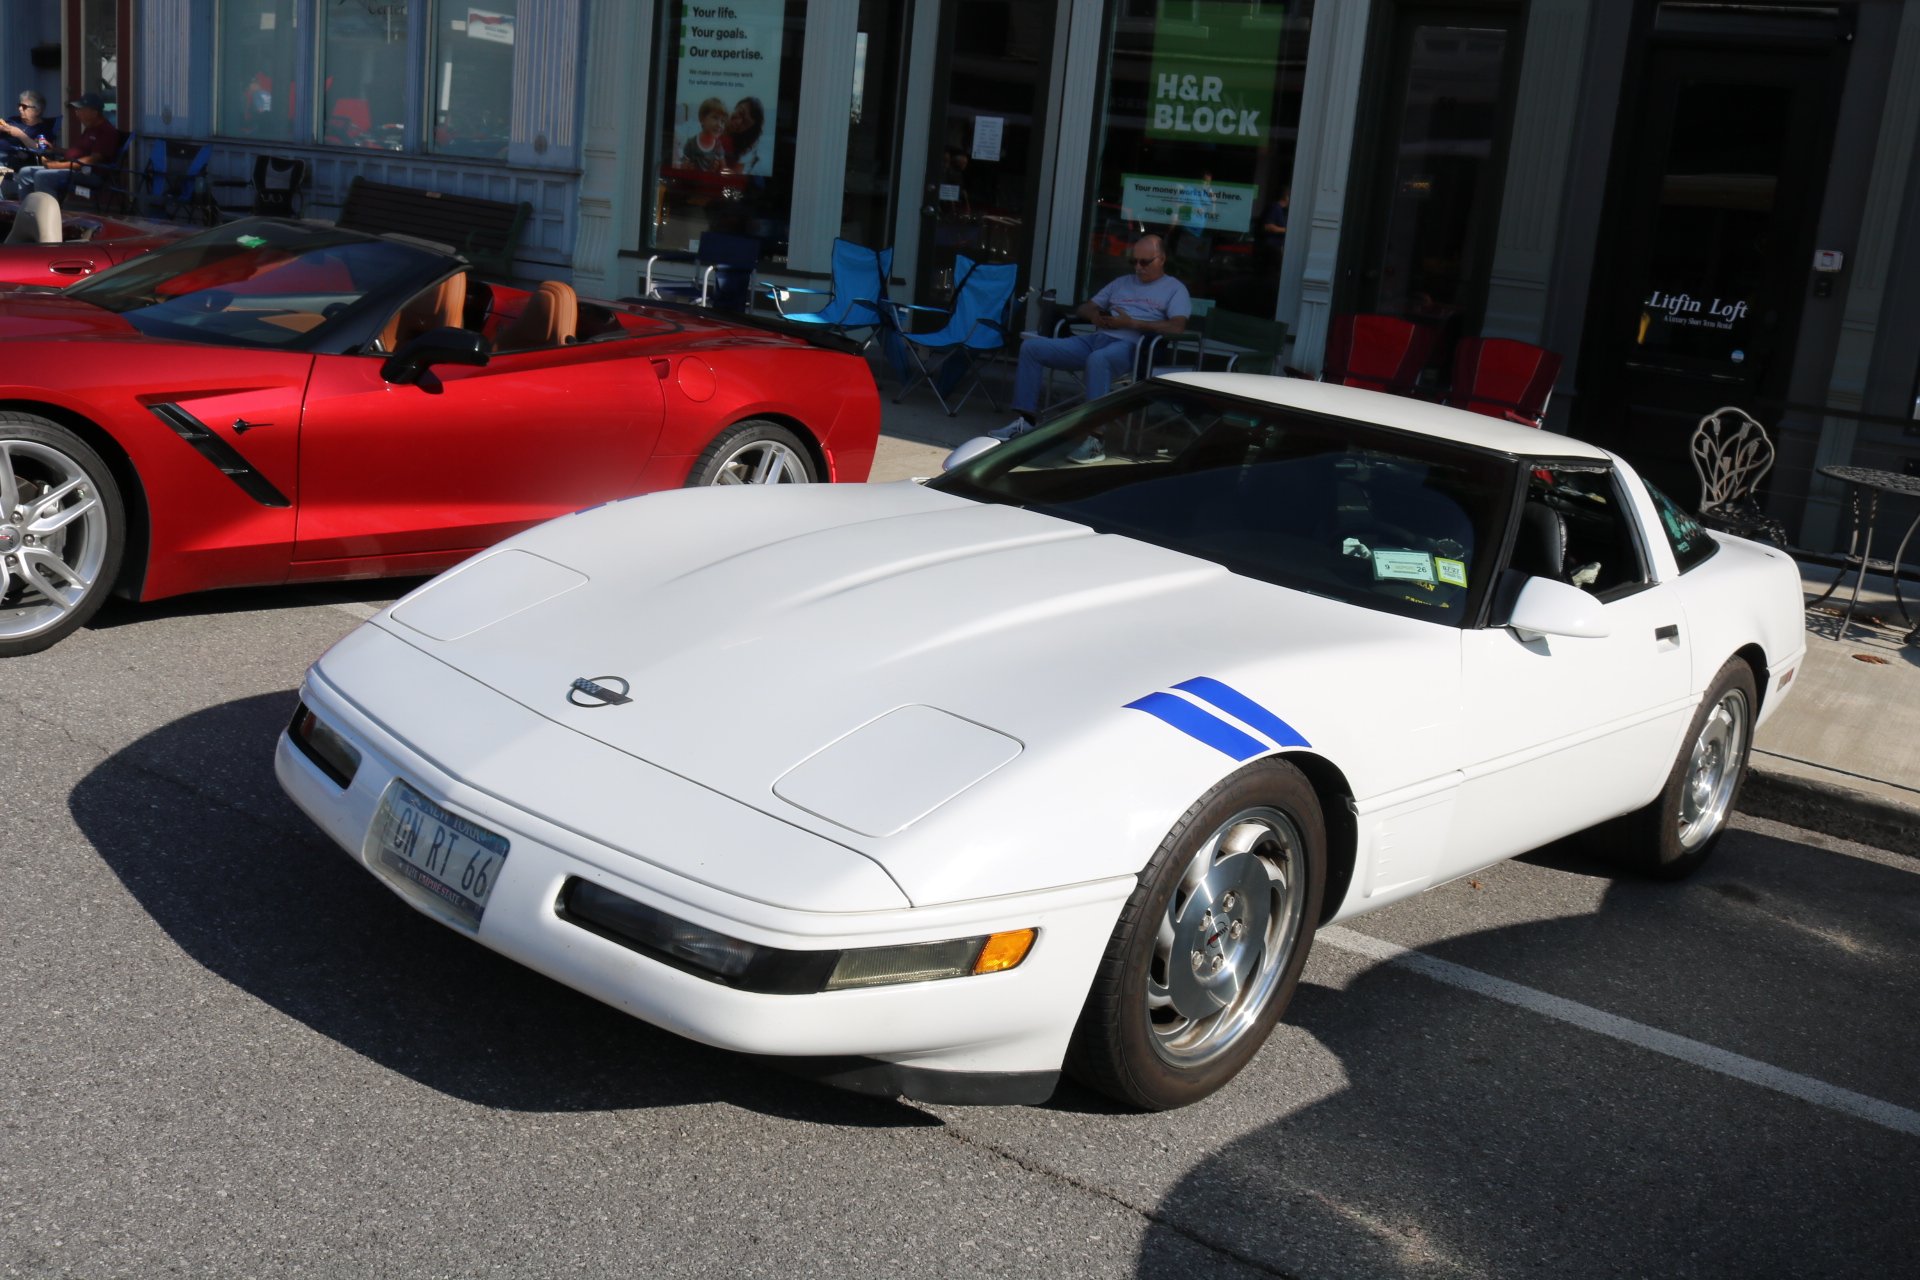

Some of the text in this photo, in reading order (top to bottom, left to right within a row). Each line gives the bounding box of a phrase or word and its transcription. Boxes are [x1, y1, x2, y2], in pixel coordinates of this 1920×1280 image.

[692, 6, 737, 19] Your life.
[691, 26, 748, 40] Your goals.
[689, 46, 764, 61] Our expertise.
[1156, 73, 1223, 102] H&R
[1153, 104, 1261, 136] BLOCK
[1134, 183, 1151, 193] Your
[1152, 186, 1178, 196] money
[1179, 188, 1202, 197] works
[1203, 190, 1221, 199] hard
[1222, 191, 1242, 201] here.
[1649, 291, 1748, 322] Litfin Loft
[1669, 315, 1687, 326] Luxury
[1688, 317, 1702, 326] Short
[1702, 319, 1716, 328] Term
[1716, 321, 1733, 330] Rental
[453, 820, 481, 841] YORK
[393, 807, 493, 898] GN RT 66
[418, 873, 442, 893] EMPIRE
[441, 884, 462, 906] STATE
